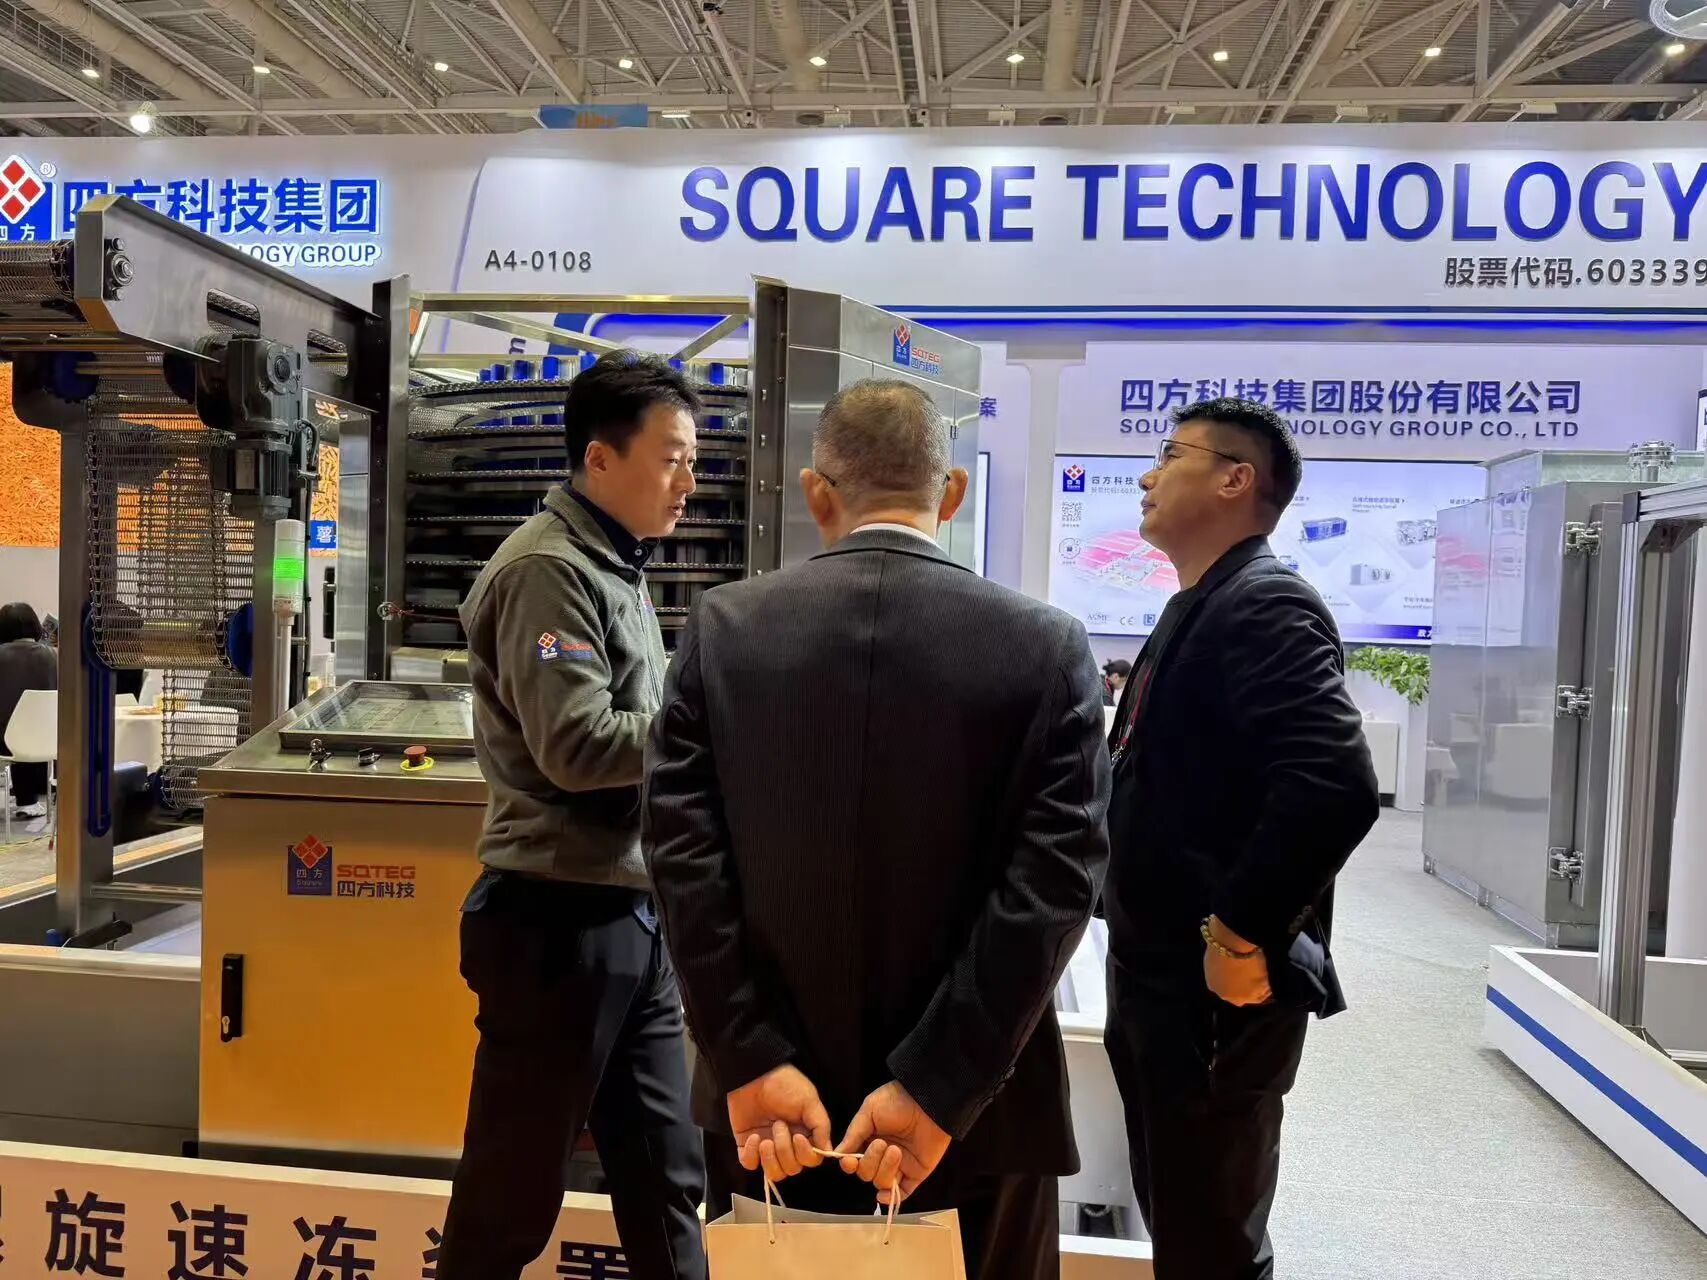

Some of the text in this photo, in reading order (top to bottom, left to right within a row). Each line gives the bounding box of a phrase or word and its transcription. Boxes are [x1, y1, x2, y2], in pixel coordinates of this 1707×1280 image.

[680, 161, 1707, 243] SQUARE TECHNOLOGY
[301, 245, 376, 263] GROUP
[484, 249, 592, 272] A4-0108
[1120, 418, 1579, 440] SQU NOLOGY GROUP CO., LTD
[1091, 476, 1139, 486] 四方科技
[337, 880, 415, 898] 四方科技
